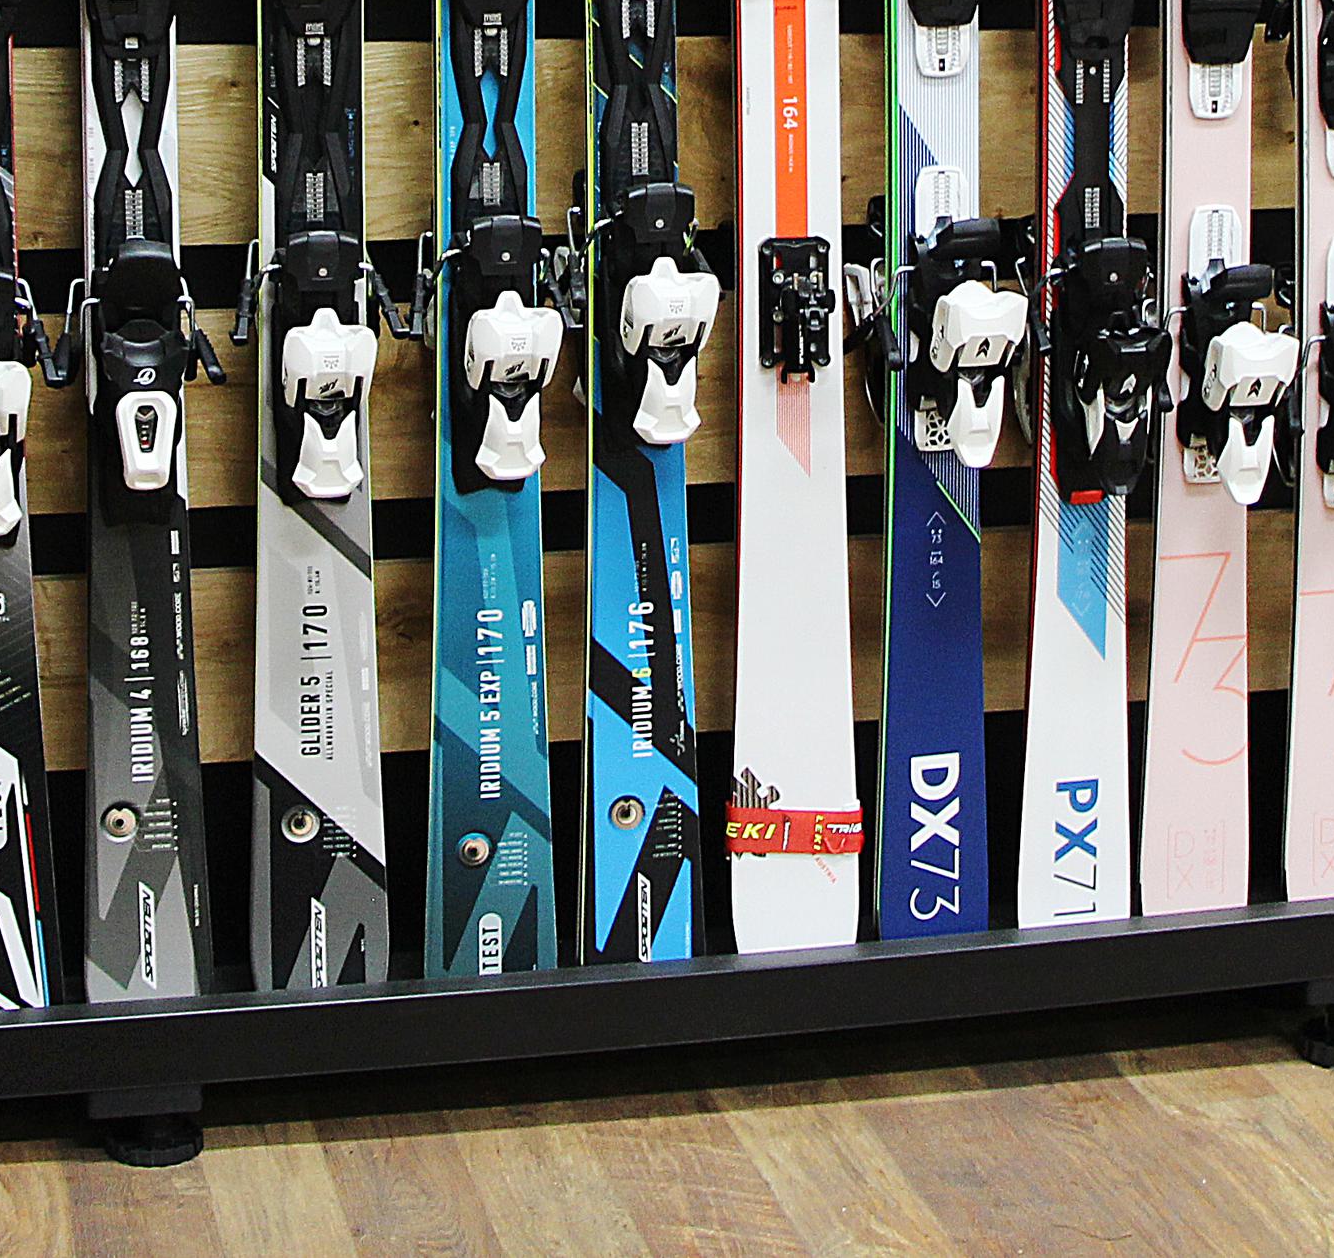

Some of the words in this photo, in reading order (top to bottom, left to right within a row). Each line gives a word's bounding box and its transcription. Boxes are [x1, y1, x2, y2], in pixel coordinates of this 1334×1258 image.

[782, 95, 798, 130] 164
[302, 604, 329, 651] 170
[477, 609, 504, 656] 170
[628, 601, 655, 649] 176
[130, 636, 151, 672] 168
[632, 667, 652, 679] 6
[130, 688, 153, 700] 4
[301, 675, 321, 687] 5
[479, 670, 501, 705] EXP
[300, 694, 322, 758] GLIDER
[480, 710, 501, 722] 5
[631, 685, 654, 759] IRIDIUM
[130, 706, 155, 784] IRIDIUM
[479, 728, 501, 799] IRIDIUM
[813, 814, 822, 850] LEKI
[909, 752, 961, 920] DX73
[1054, 778, 1099, 917] PX71
[140, 888, 156, 986] SPORTEN
[639, 879, 650, 959] SPORTEN
[482, 926, 499, 973] TEST
